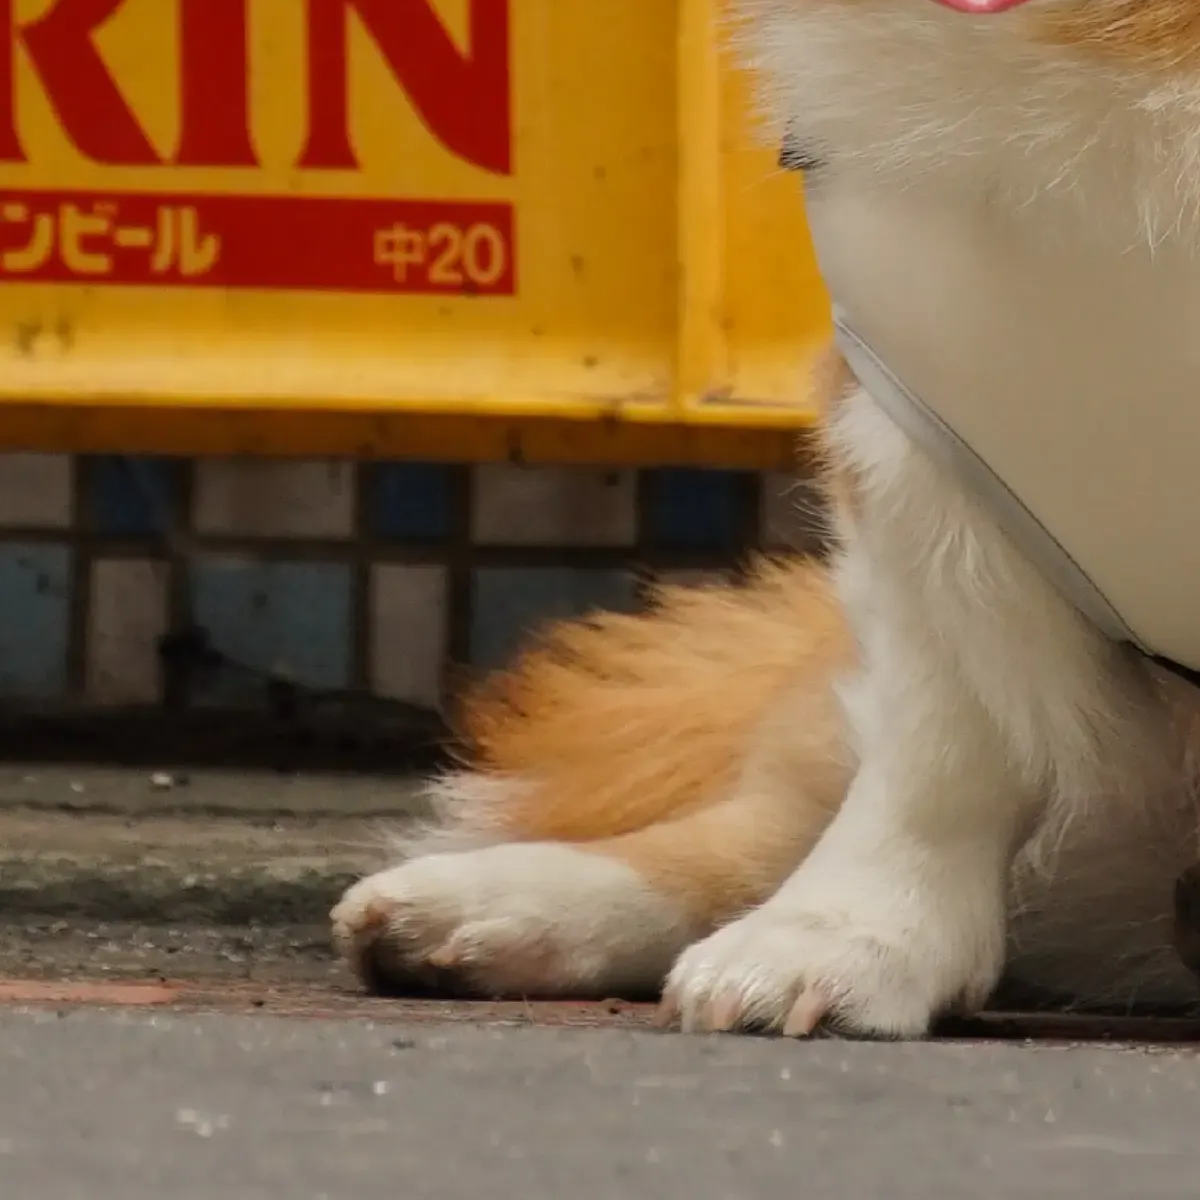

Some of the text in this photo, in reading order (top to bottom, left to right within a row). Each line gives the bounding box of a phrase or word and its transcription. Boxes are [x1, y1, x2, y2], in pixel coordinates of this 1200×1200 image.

[2, 202, 505, 283] ンビール 中20
